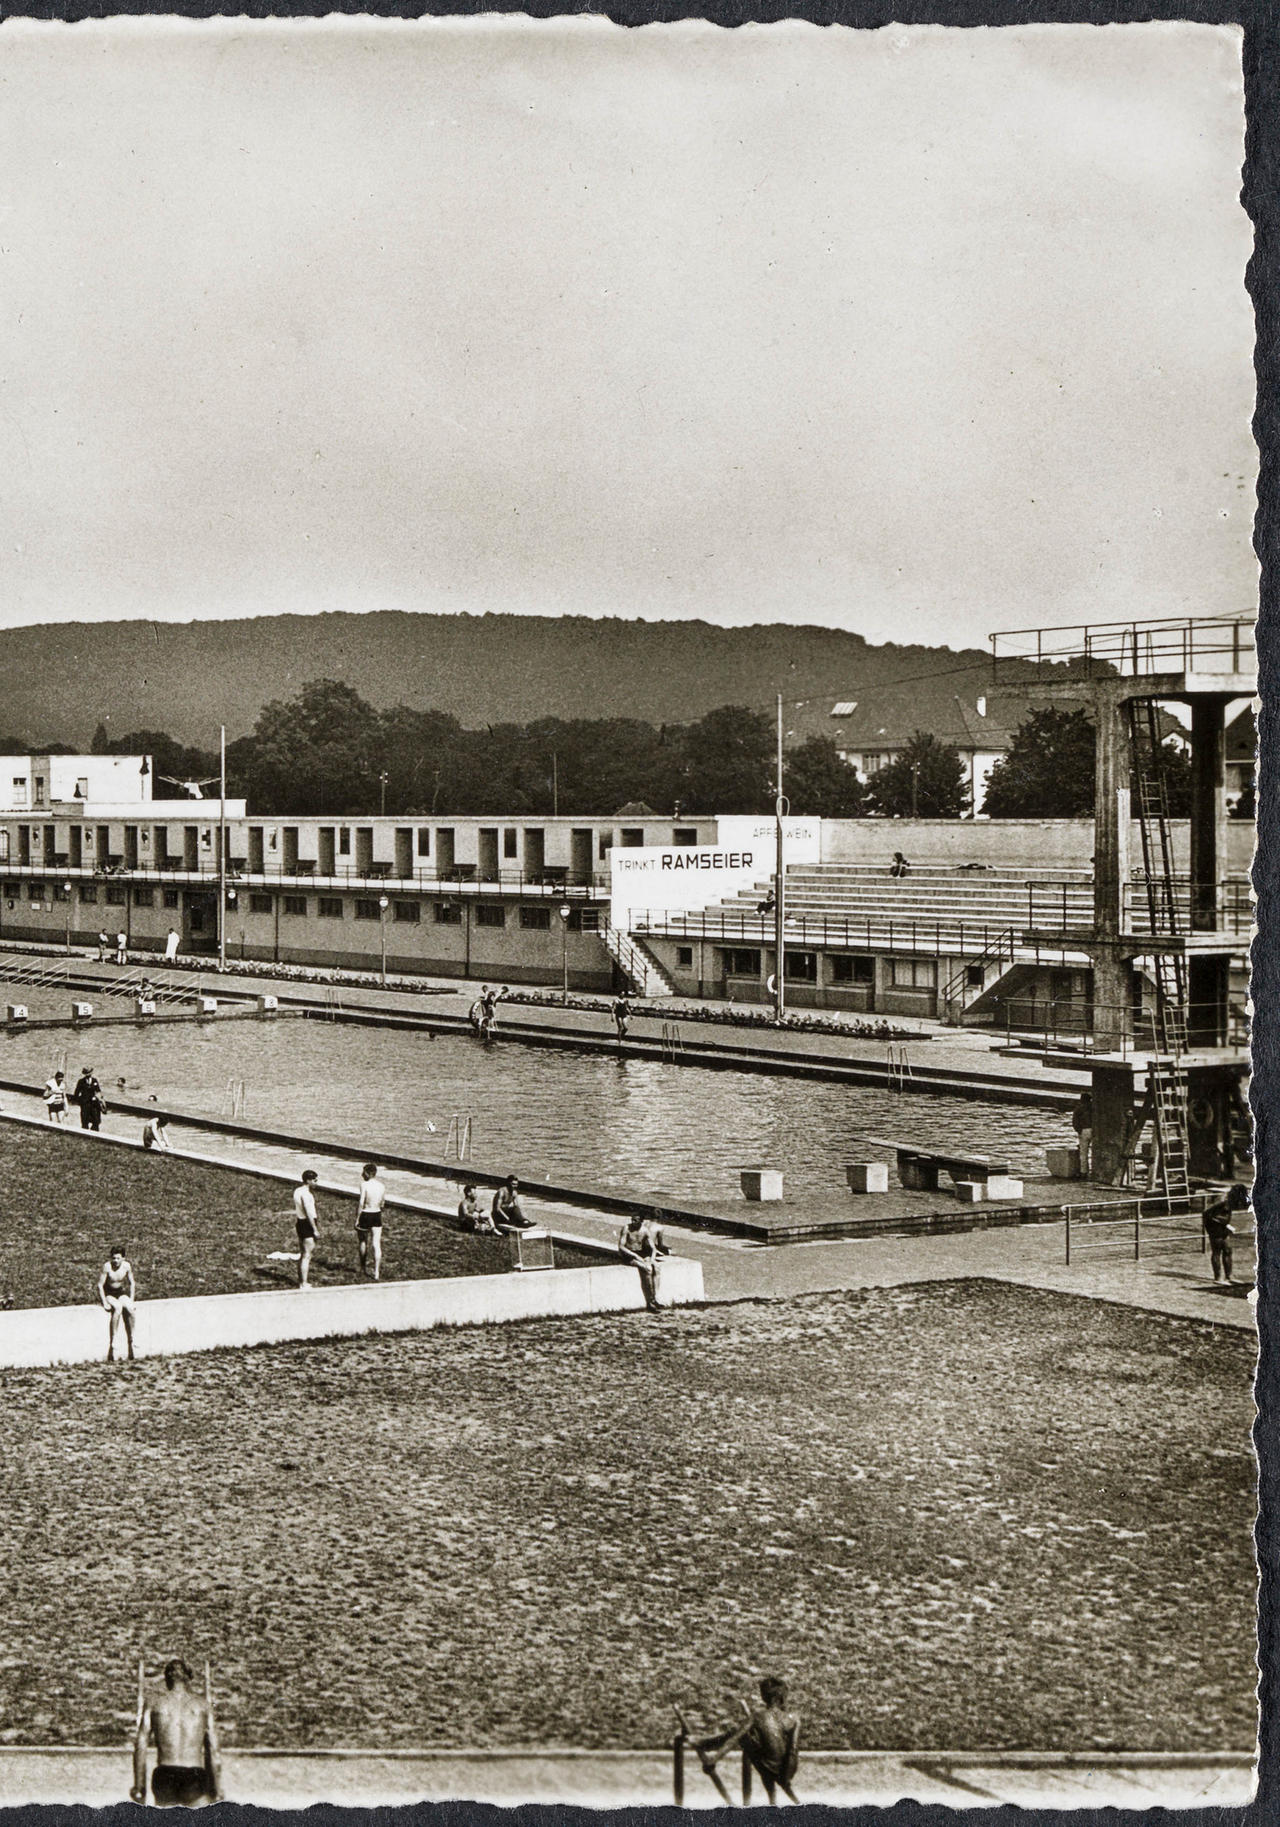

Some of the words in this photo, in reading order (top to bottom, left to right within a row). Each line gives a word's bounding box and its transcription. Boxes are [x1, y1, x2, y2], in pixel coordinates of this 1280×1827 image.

[618, 859, 656, 871] TRINKT
[662, 852, 753, 870] RAMSEIER
[83, 1006, 89, 1015] 5
